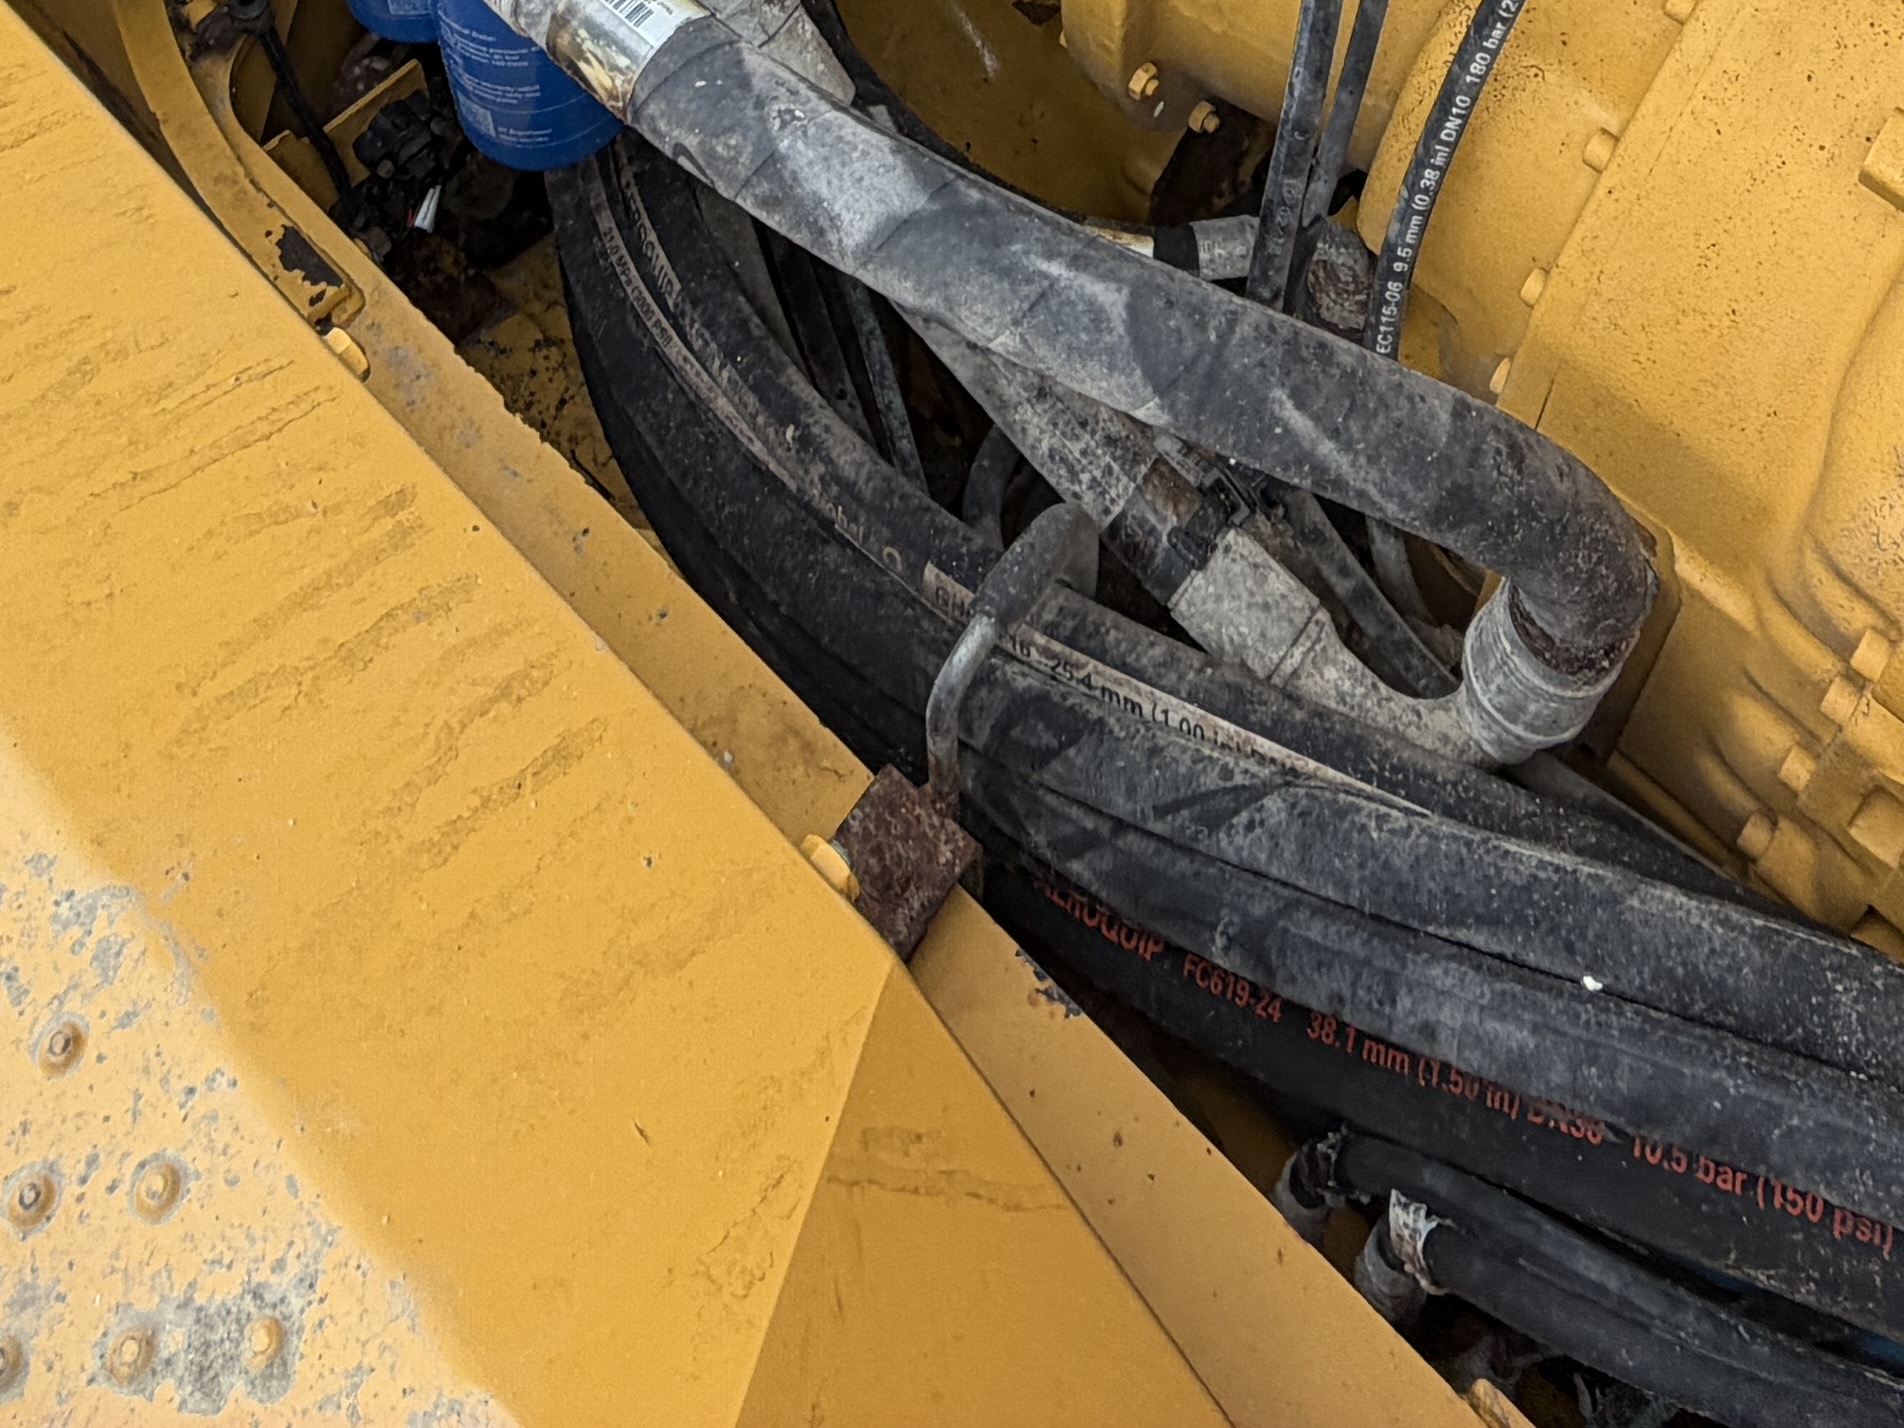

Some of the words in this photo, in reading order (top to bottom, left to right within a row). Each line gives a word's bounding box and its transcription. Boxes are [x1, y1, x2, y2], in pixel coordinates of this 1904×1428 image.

[1483, 22, 1506, 50] bar
[1465, 52, 1491, 84] 180
[1440, 95, 1471, 143] DN10
[1411, 169, 1440, 211] (0.38
[1405, 215, 1423, 243] mm
[1393, 246, 1413, 272] 9.5
[1376, 281, 1403, 354] EC115-06
[1101, 685, 1144, 719] mm
[1182, 953, 1283, 1023] FC619-24
[1307, 1012, 1355, 1055] 38.1
[1363, 1038, 1410, 1075] mm
[1416, 1051, 1481, 1102] (1.50
[1696, 1154, 1748, 1197] bar
[1756, 1175, 1825, 1224] (150
[1833, 1206, 1894, 1261] psi)
